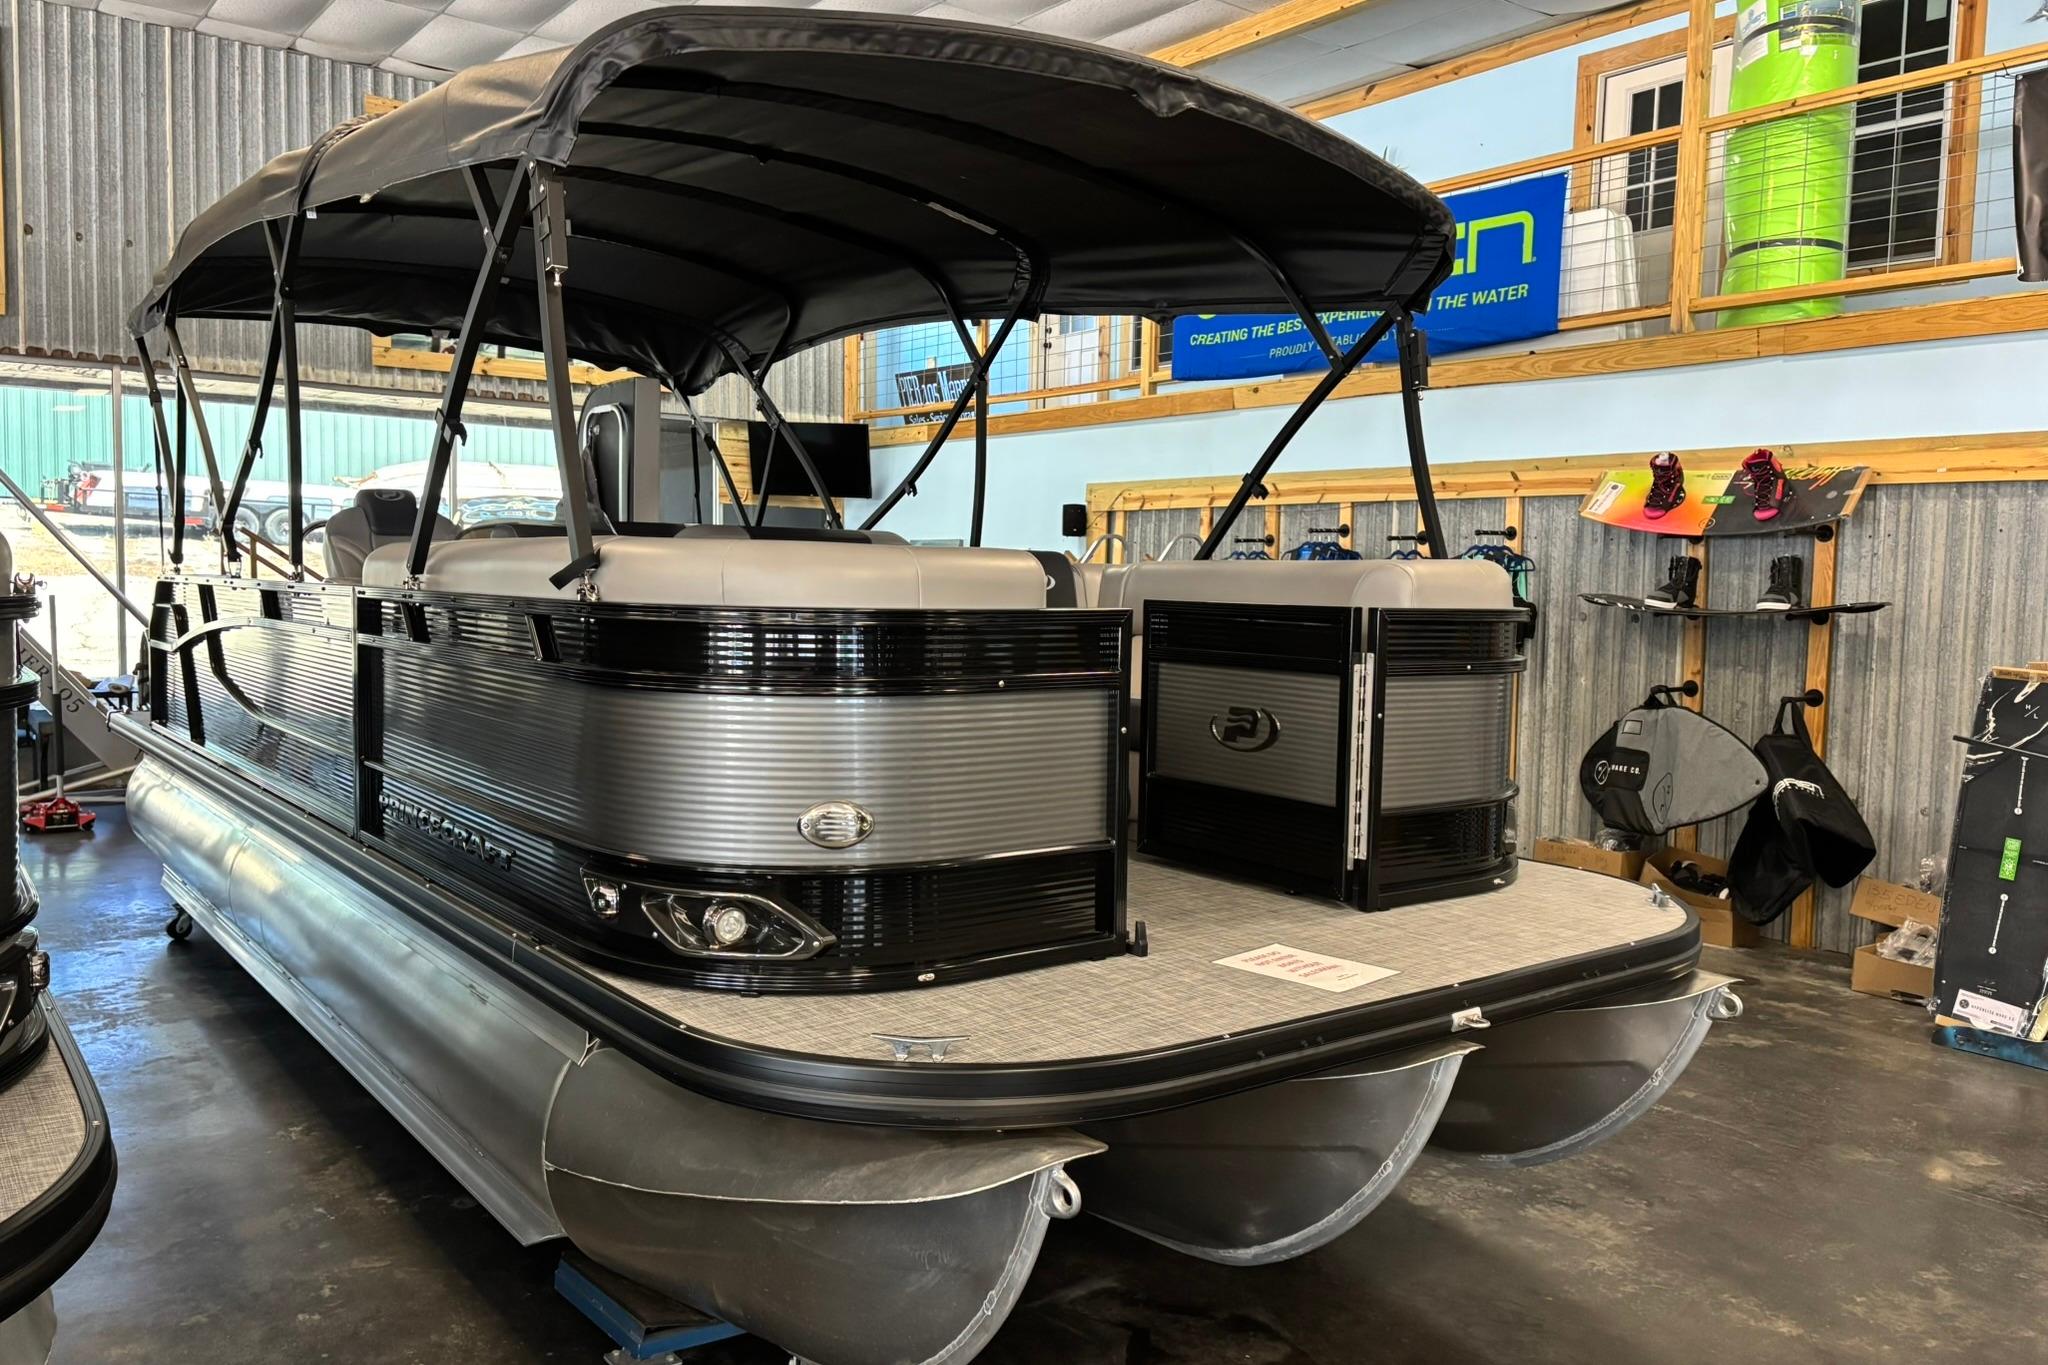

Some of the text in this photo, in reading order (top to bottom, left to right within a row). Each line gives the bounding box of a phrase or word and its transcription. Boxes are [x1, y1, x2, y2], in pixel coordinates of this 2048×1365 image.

[1436, 293, 1469, 310] THE
[1472, 283, 1529, 306] WATER
[1190, 328, 1248, 346] CREATING
[1251, 323, 1275, 339] THE
[1277, 318, 1307, 335] BES
[1269, 341, 1314, 359] PROUDLY
[898, 375, 923, 408] PIER
[920, 383, 940, 405] 105
[47, 685, 86, 713] 05
[379, 794, 513, 872] PRINCECRAFT
